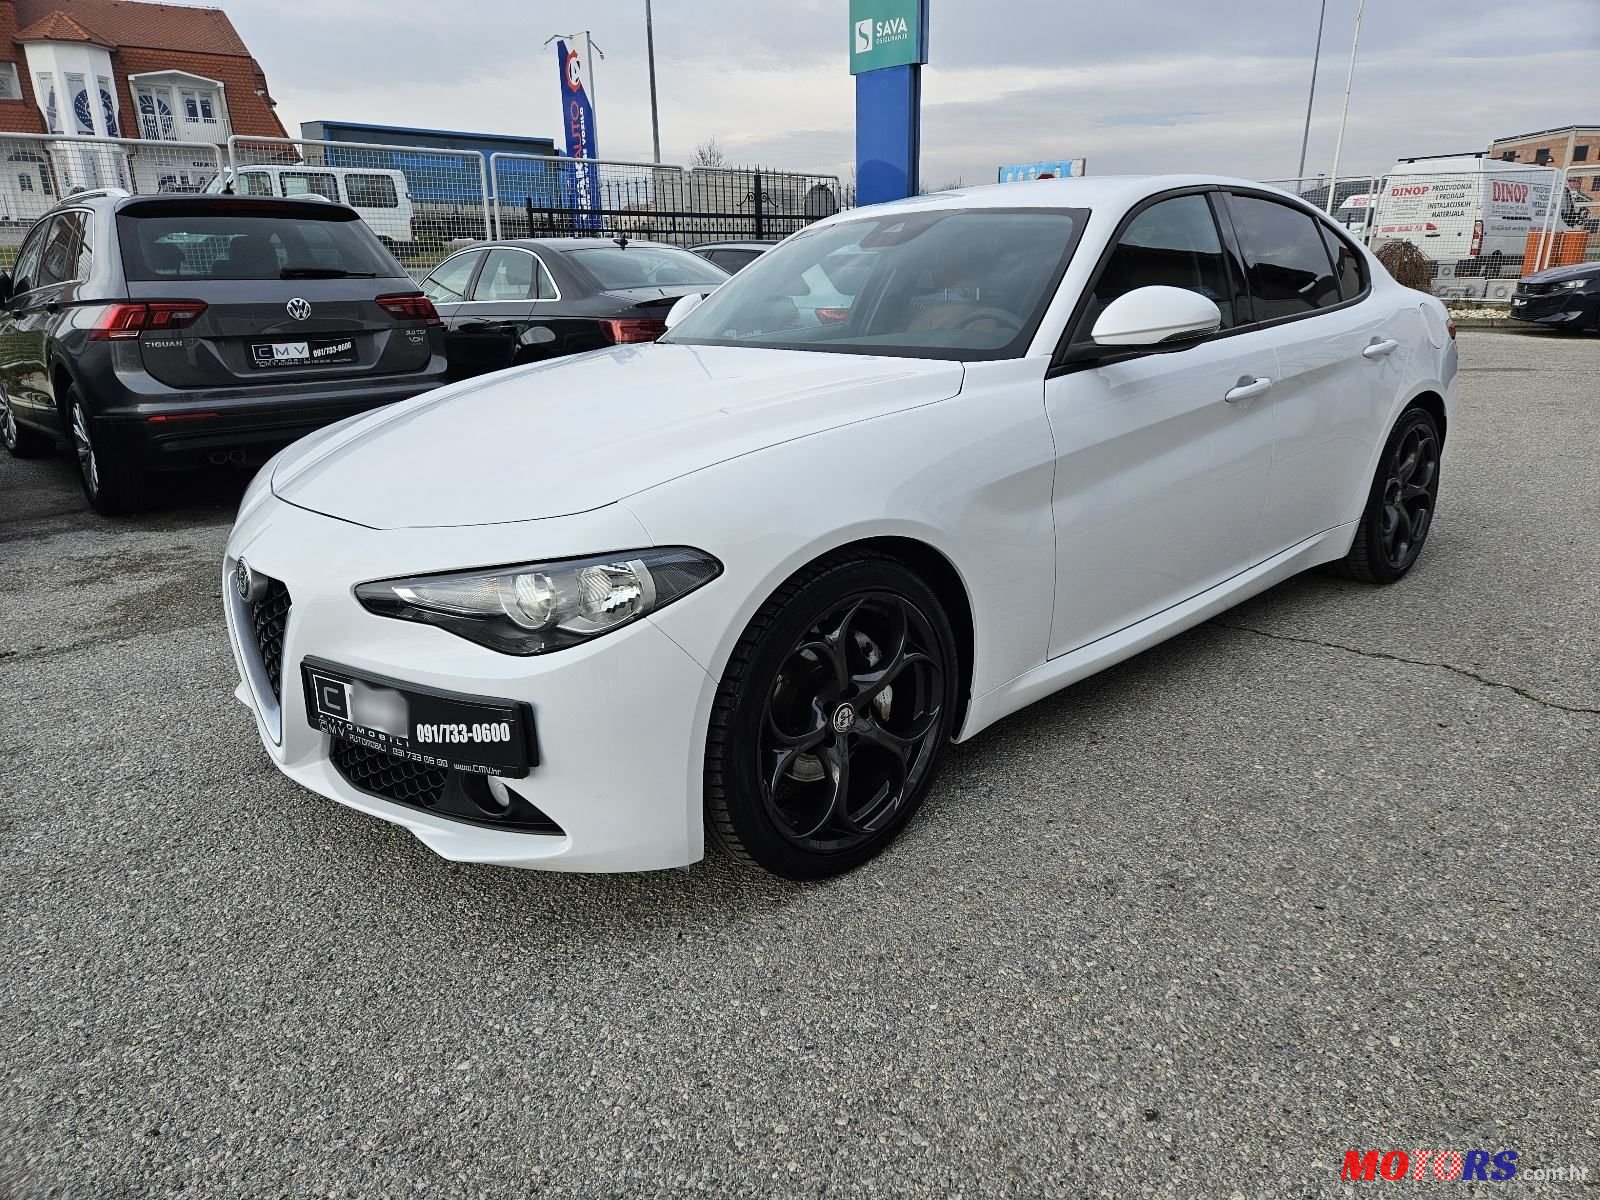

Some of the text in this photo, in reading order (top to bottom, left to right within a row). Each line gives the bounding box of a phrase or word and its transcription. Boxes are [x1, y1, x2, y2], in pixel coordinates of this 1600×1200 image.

[876, 16, 908, 38] SAVA
[1391, 186, 1429, 197] DINOP
[1492, 182, 1529, 203] DINOP
[144, 340, 183, 349] TIGUAN
[416, 722, 511, 744] 091/733-0600
